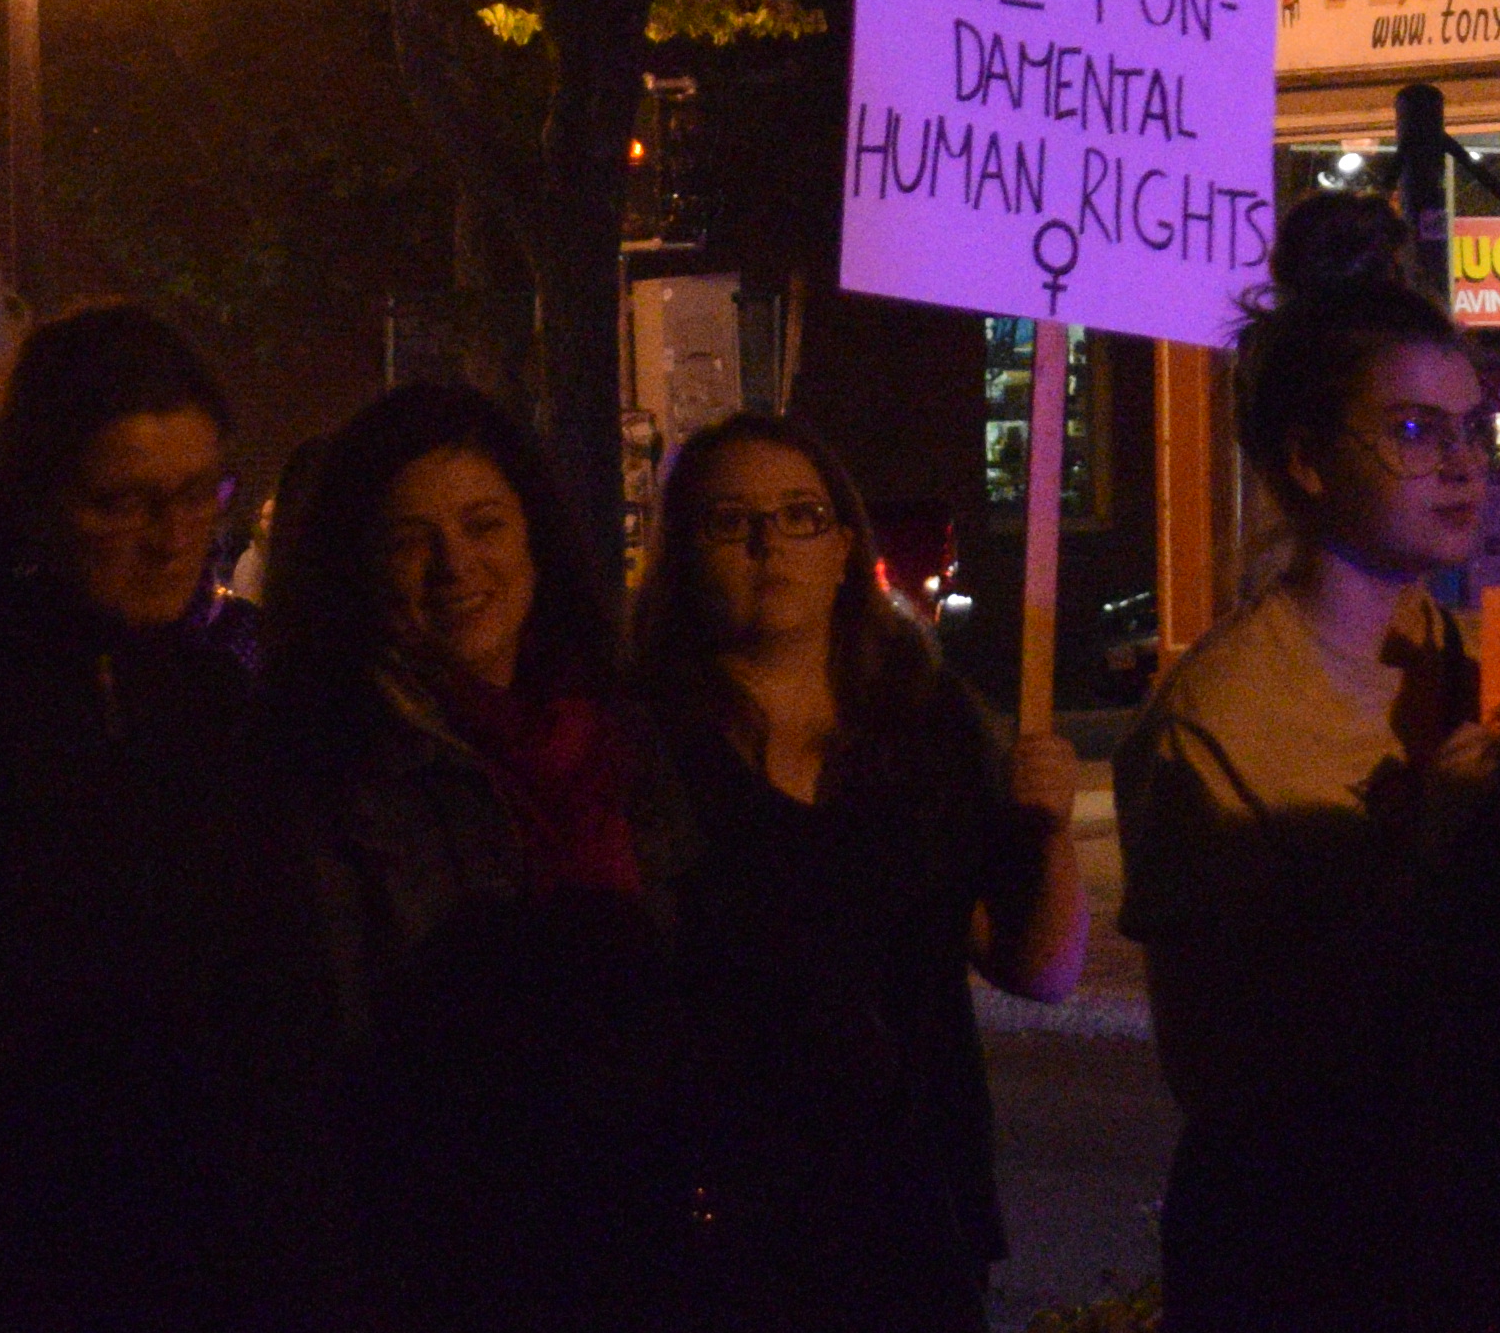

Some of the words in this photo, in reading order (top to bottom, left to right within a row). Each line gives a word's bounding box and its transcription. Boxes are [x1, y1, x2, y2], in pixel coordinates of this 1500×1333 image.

[955, 19, 1197, 139] DAMENTAL
[854, 104, 1045, 214] HUMAN
[1078, 147, 1269, 270] RIGHTS
